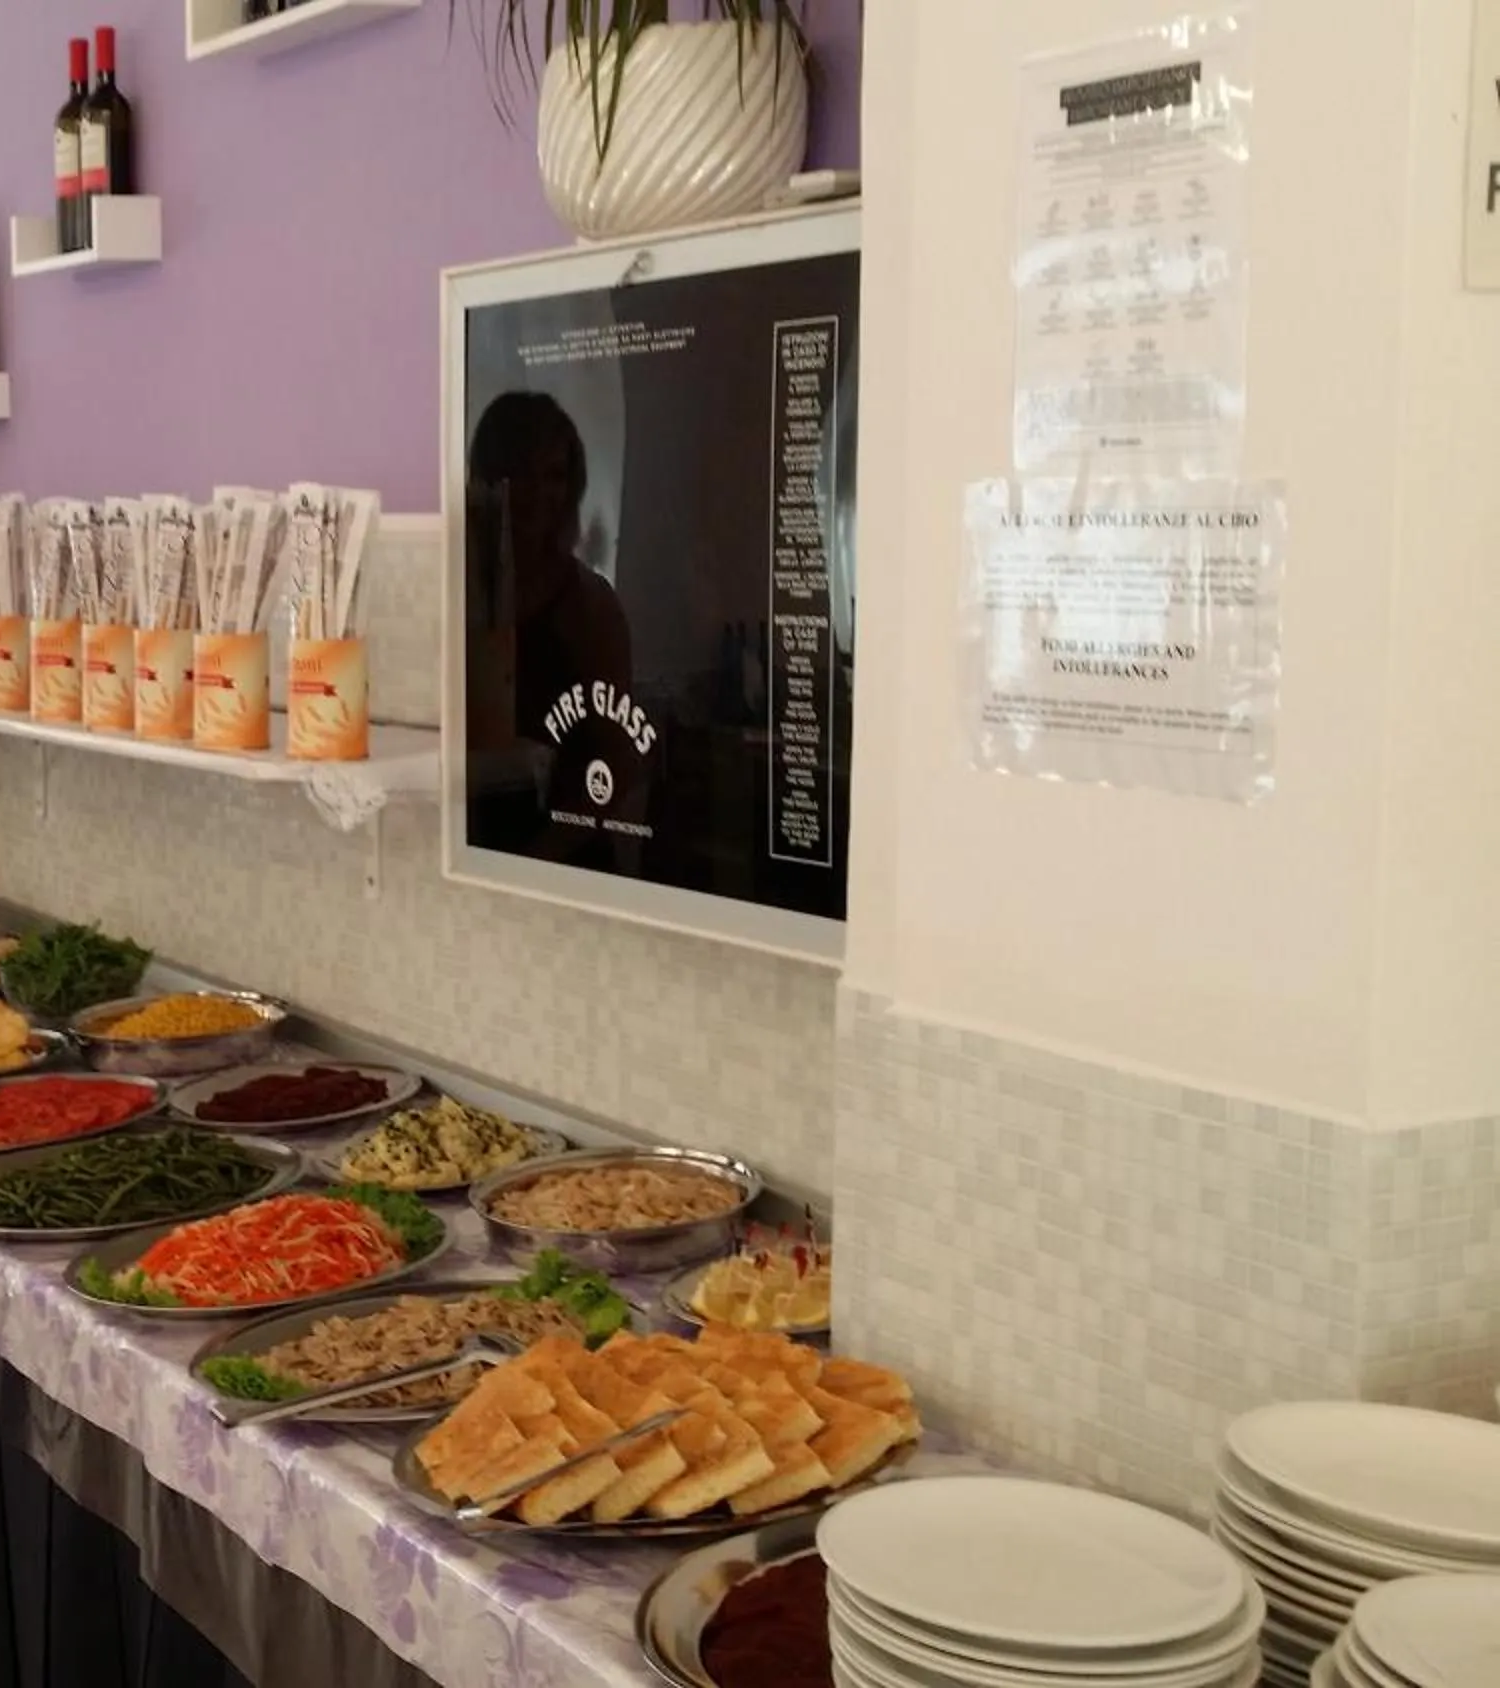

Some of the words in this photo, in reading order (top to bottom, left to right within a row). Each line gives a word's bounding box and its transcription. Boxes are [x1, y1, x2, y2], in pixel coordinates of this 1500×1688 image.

[1165, 643, 1195, 660] AND
[544, 682, 587, 744] FIRE
[592, 679, 657, 755] GLASS
